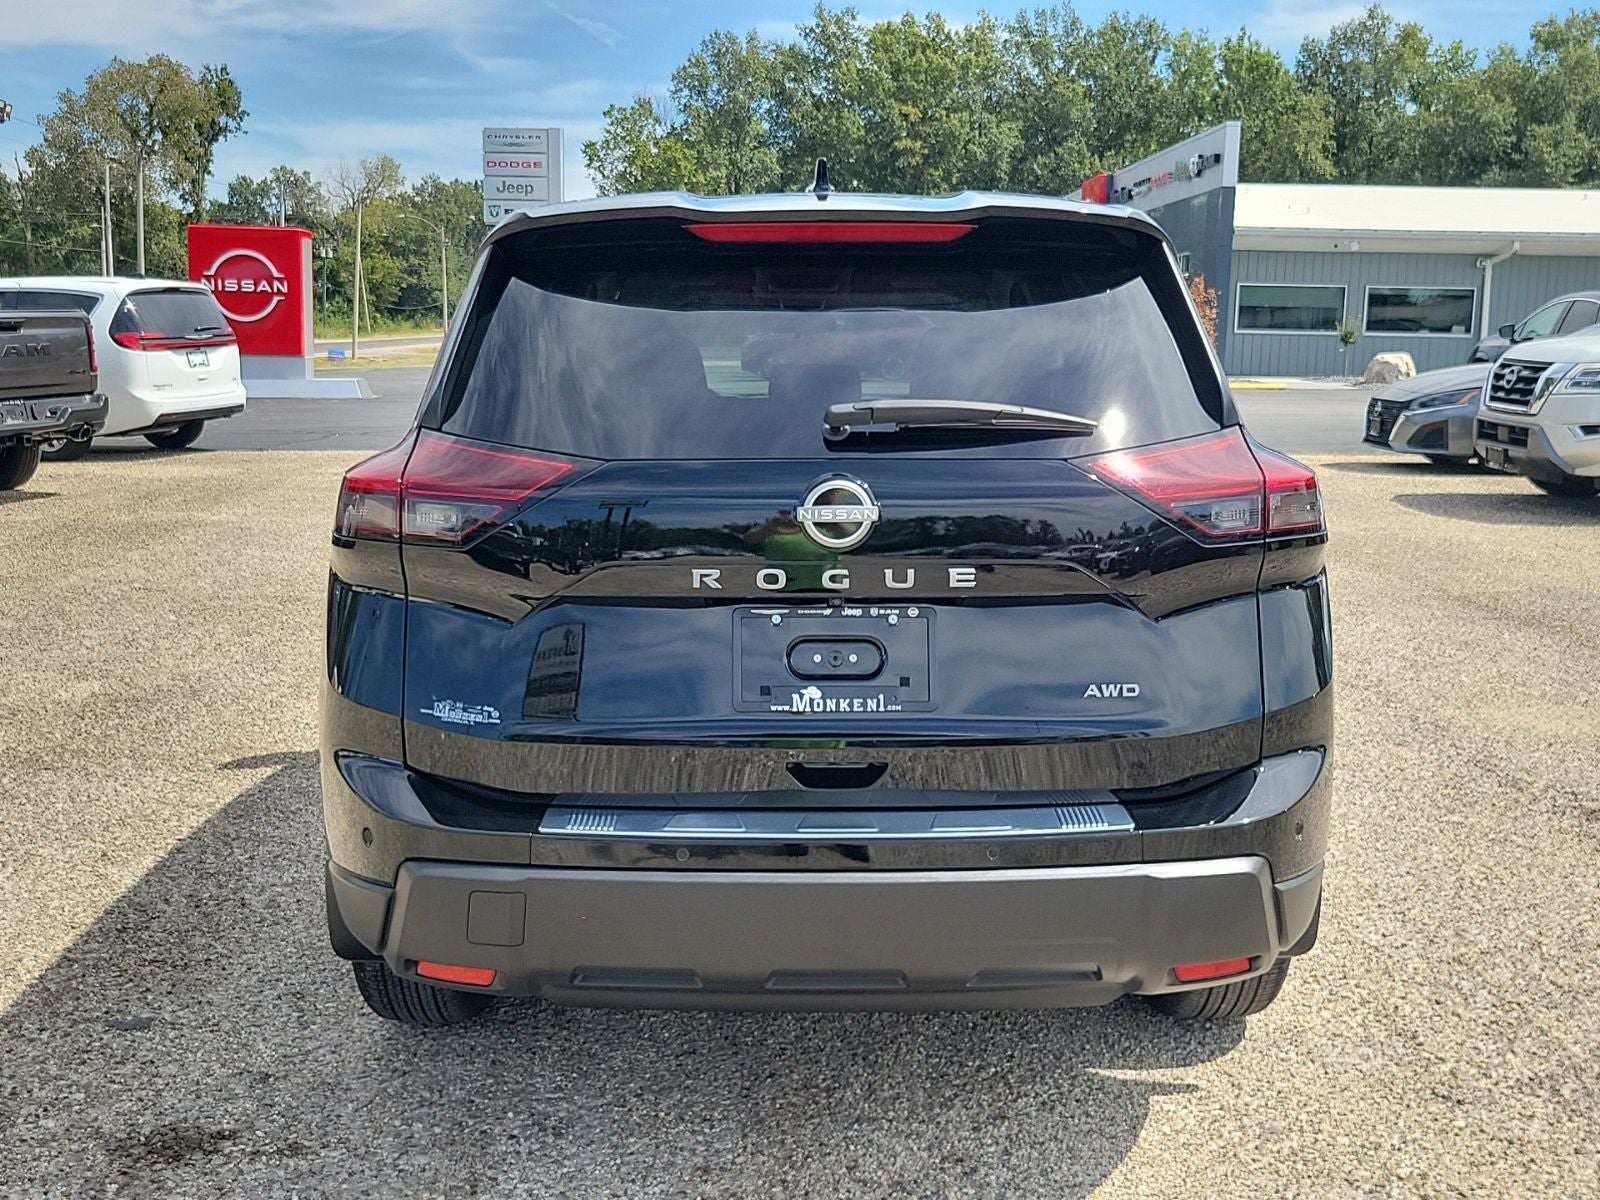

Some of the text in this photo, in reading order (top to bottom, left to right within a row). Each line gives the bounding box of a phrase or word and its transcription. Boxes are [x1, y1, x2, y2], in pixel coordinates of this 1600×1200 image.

[486, 160, 543, 169] DODGE
[496, 180, 534, 197] Jeep
[201, 277, 288, 293] NISSAN
[0, 342, 51, 358] AM
[799, 508, 876, 520] NISSAN
[691, 567, 978, 590] ROGUE
[841, 607, 863, 617] Jeep
[1083, 683, 1140, 698] AWD
